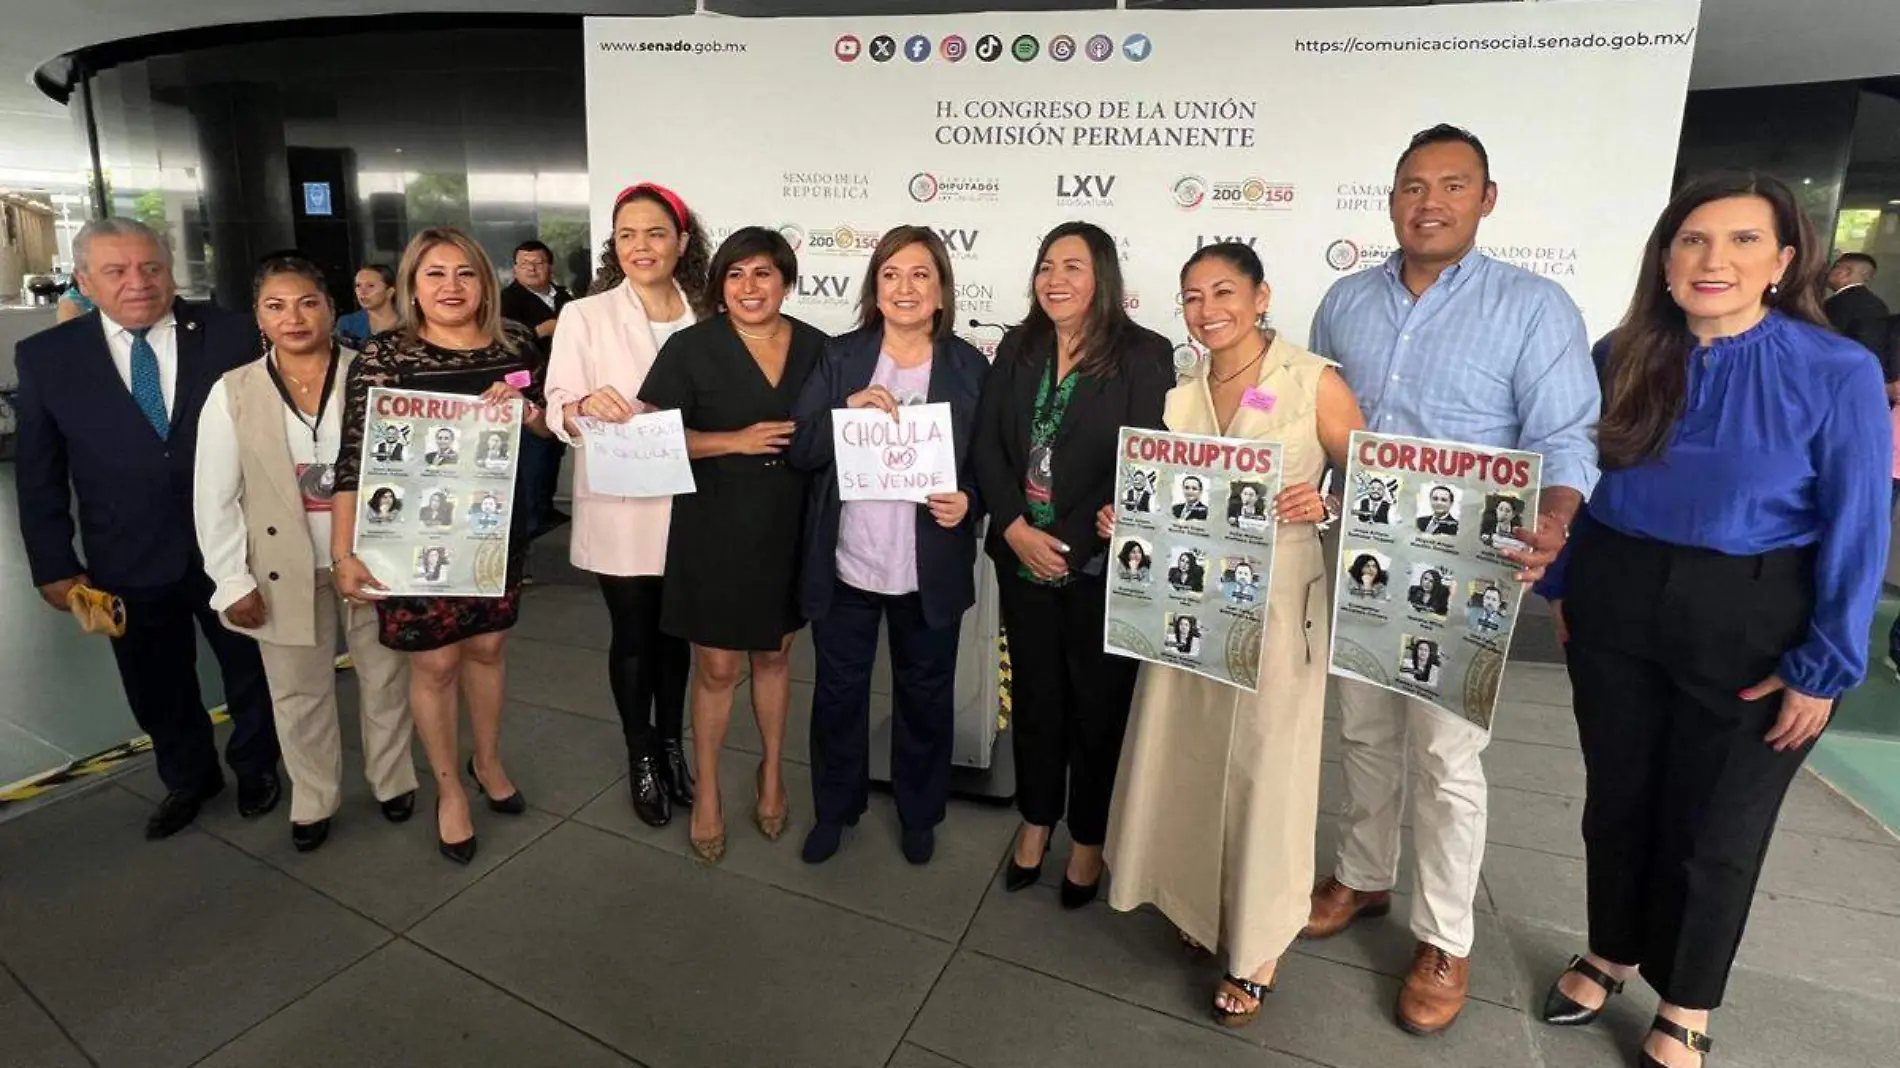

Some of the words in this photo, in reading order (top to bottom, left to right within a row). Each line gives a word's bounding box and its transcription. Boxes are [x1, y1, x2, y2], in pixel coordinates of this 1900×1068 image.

[600, 40, 748, 54] www.senado.gob.mx
[1294, 28, 1694, 54] https://comunicacionsocial.senado.gob.mx/
[935, 100, 959, 119] H.
[964, 100, 1092, 119] CONGRESO
[1099, 101, 1129, 119] DE
[1136, 101, 1166, 119] LA
[1174, 97, 1257, 120] UNIÓN
[935, 122, 1065, 146] COMISIÓN
[1072, 127, 1256, 148] PERMANENTE
[782, 172, 832, 184] SENADO
[854, 174, 869, 185] LA
[938, 183, 1000, 191] DIPUTADOS
[1057, 175, 1116, 197] LXV
[1337, 180, 1391, 196] CÁMAR
[1212, 189, 1242, 201] 200
[1265, 190, 1293, 202] 150
[808, 236, 835, 248] 200
[940, 229, 979, 252] XV
[1535, 247, 1554, 259] DE
[1559, 248, 1577, 260] LA
[798, 275, 850, 297] LXV
[376, 394, 513, 424] CORRUPTOS
[842, 420, 942, 448] CHOLULA
[1126, 434, 1272, 474] CORRUPTOS
[1358, 439, 1530, 489] CORRUPTOS
[844, 471, 870, 488] SE
[877, 471, 945, 490] VENDE
